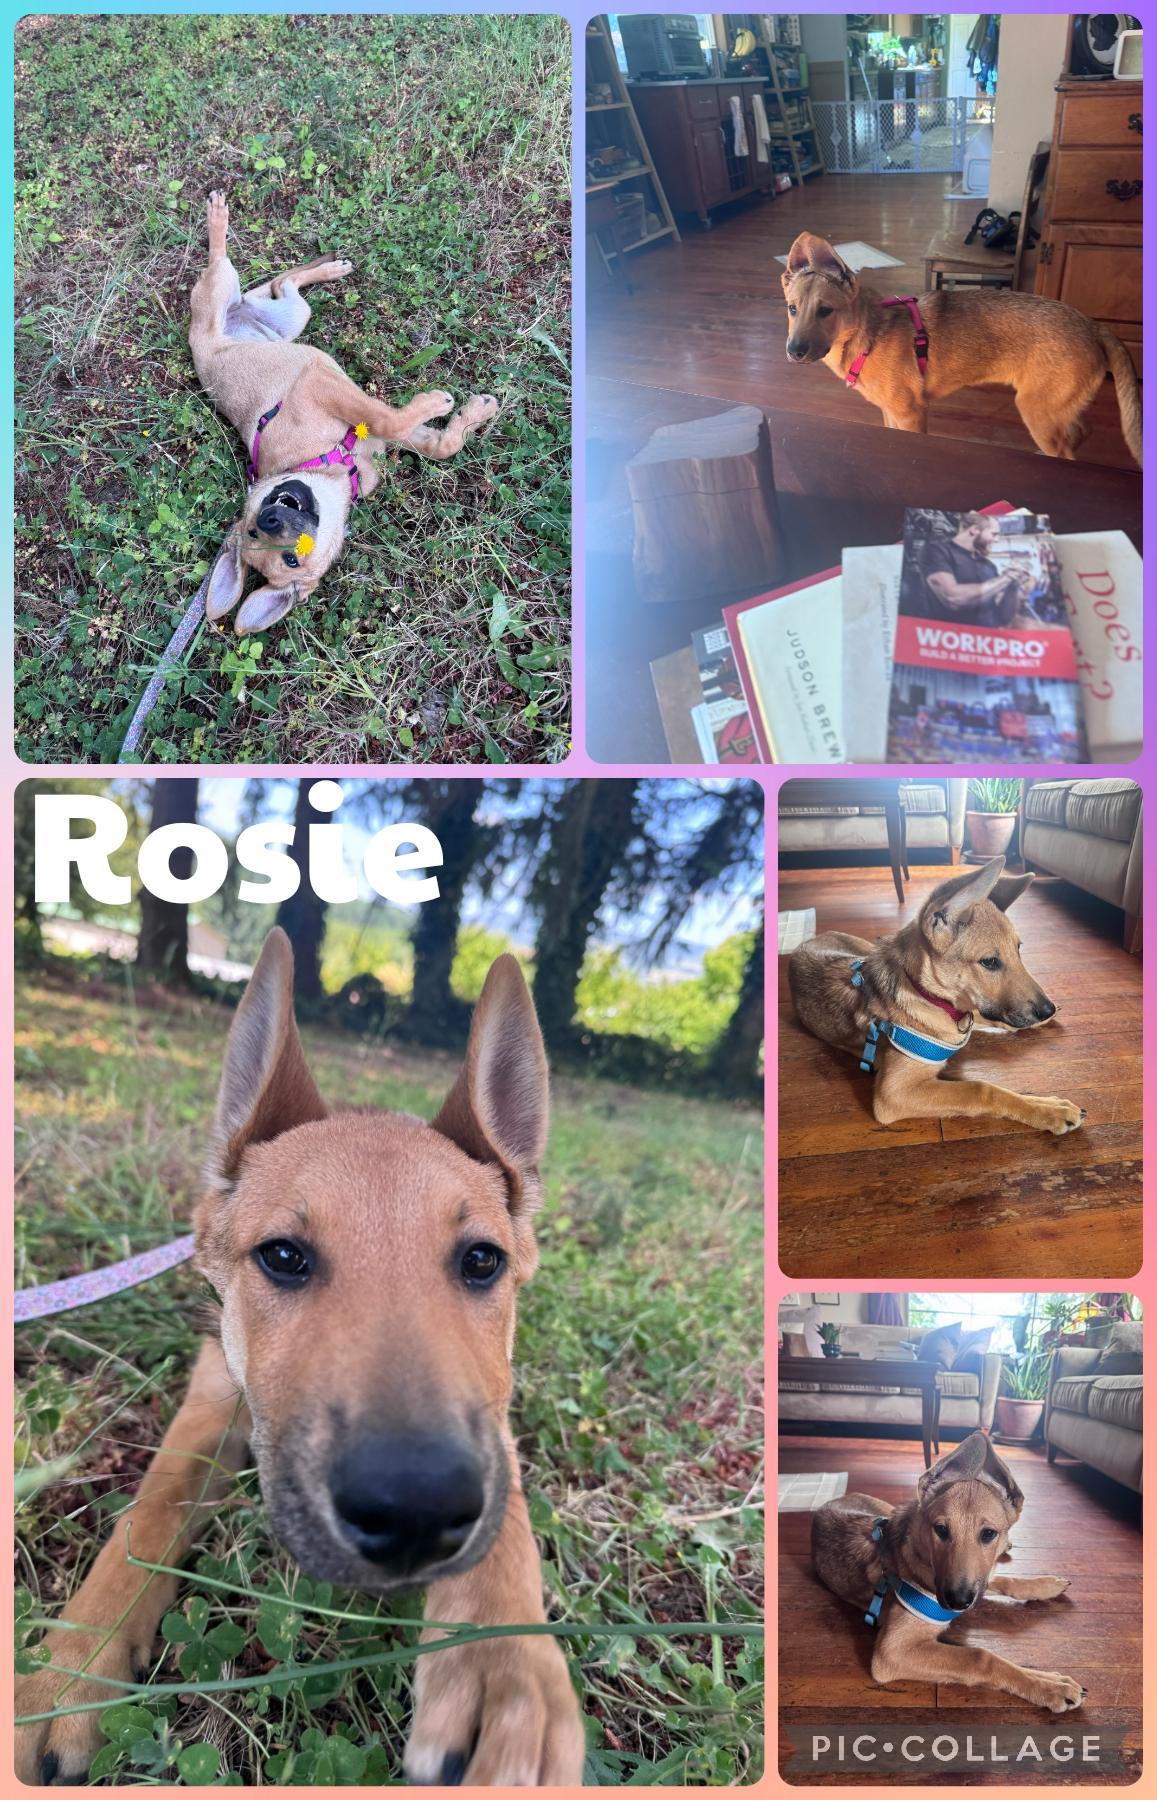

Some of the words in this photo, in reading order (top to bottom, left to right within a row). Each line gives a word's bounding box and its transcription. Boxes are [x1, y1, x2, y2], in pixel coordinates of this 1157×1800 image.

[1076, 570, 1142, 662] Does
[786, 629, 819, 696] JUDSON
[916, 626, 1045, 658] WORKPRO
[919, 647, 948, 660] BUILD
[949, 651, 957, 660] A
[959, 653, 994, 666] BETTER
[996, 657, 1040, 668] PROJECT
